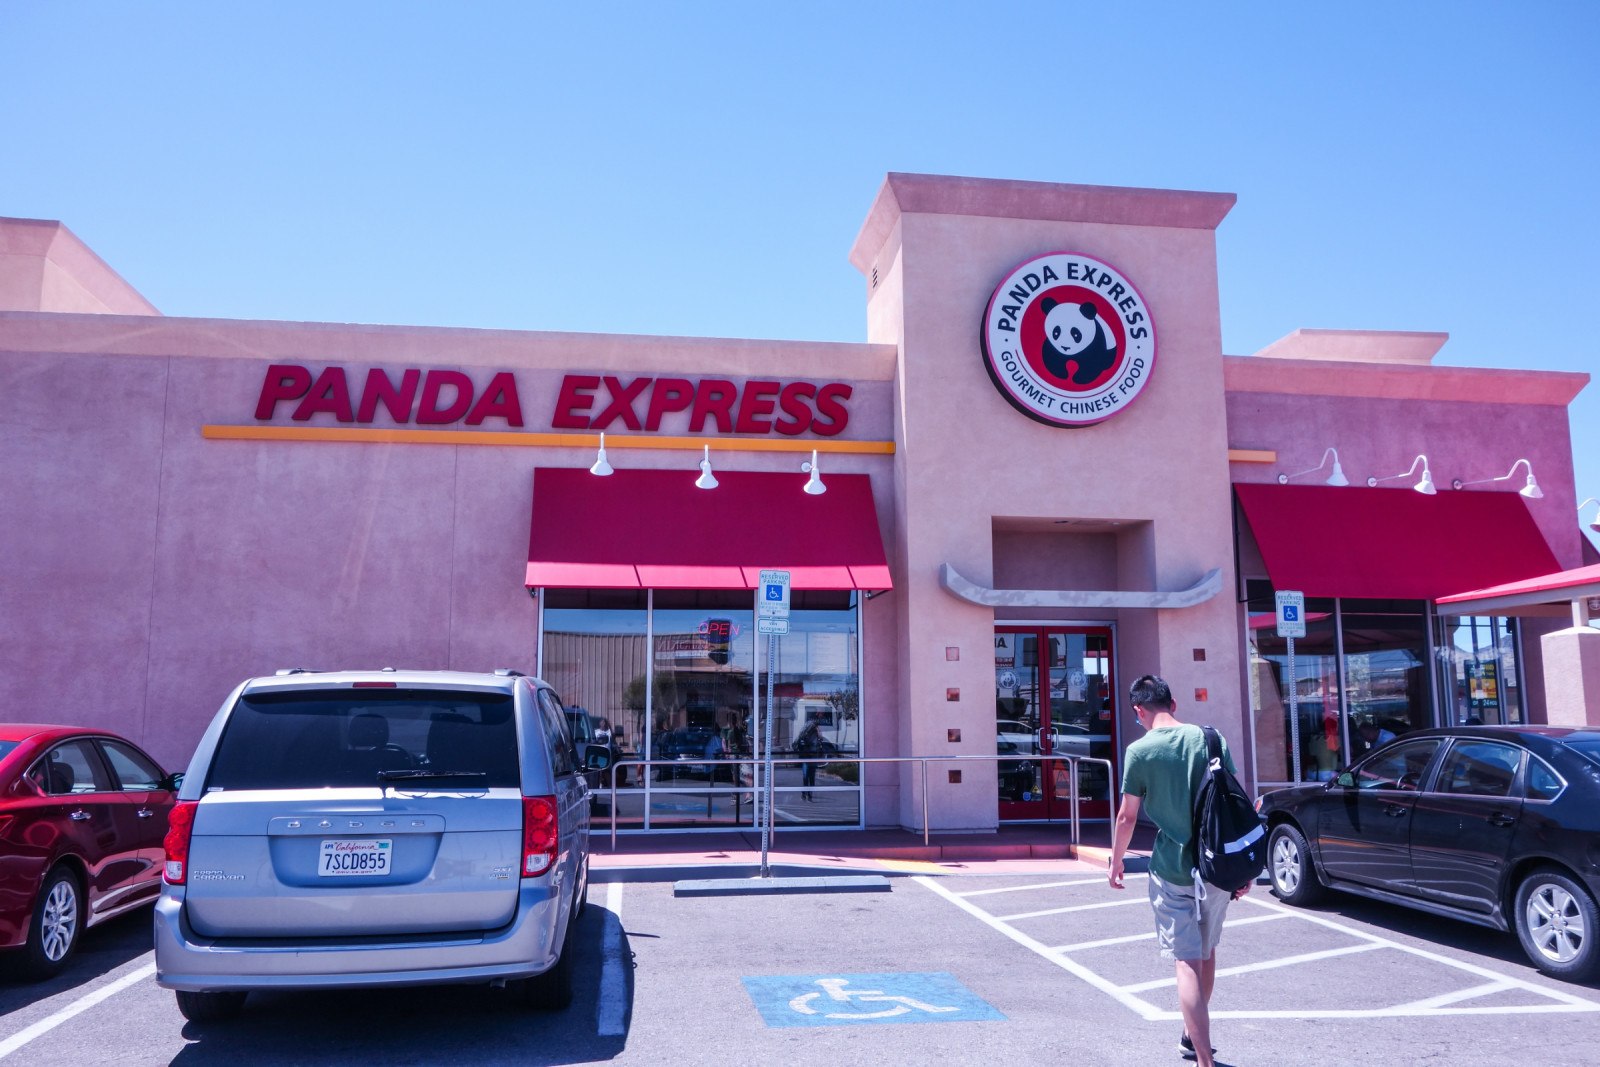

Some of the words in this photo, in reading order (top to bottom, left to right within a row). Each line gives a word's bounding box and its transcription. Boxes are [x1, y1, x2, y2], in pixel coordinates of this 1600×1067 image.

[997, 264, 1060, 332] PANDA
[1067, 262, 1148, 340] EXPRESS
[254, 364, 524, 428] PANDA
[551, 374, 853, 436] EXPRESS
[1001, 351, 1056, 409] GOURMET
[1060, 392, 1119, 415] CHINESE
[1118, 357, 1145, 395] FOOD
[698, 622, 740, 635] OPEN
[324, 852, 386, 870] 7SCD855
[335, 842, 379, 853] California
